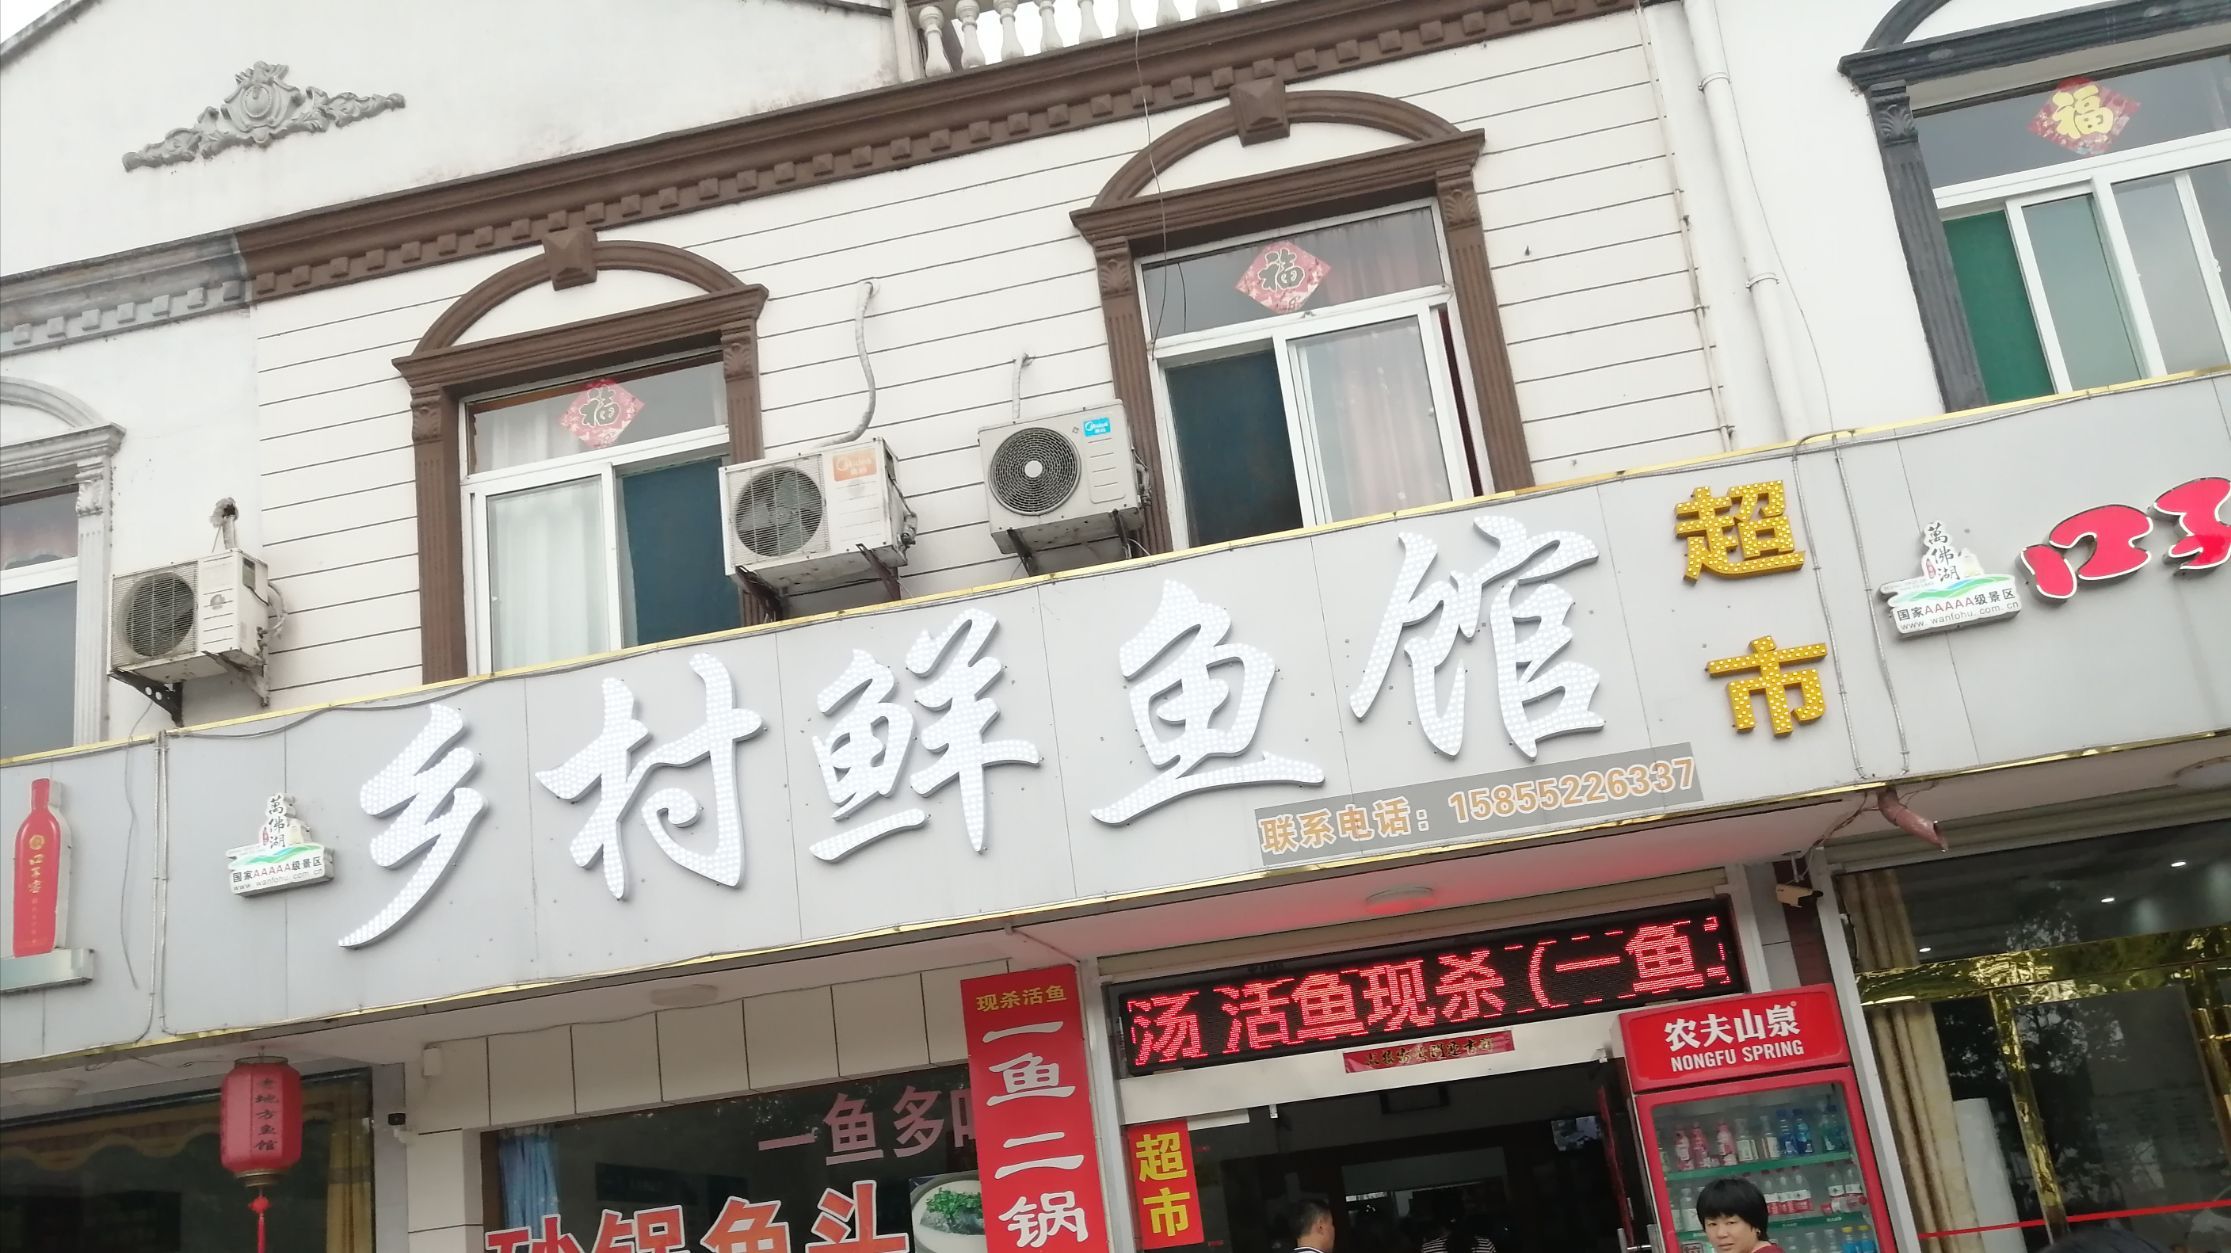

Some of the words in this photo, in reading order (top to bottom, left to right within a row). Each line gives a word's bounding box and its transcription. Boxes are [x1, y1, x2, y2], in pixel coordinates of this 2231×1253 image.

[2052, 84, 2114, 139] 福
[1257, 247, 1305, 291] 福
[579, 385, 621, 427] 福
[1675, 479, 1828, 738] 超市
[1896, 588, 2016, 621] 国家AAAAA级景区
[338, 514, 1606, 950] 乡村鲜鱼馆
[1448, 757, 1697, 824] 15855226337
[976, 985, 1067, 1012] 现杀活鱼
[1664, 1004, 1801, 1052] 农夫山泉
[1671, 1048, 1737, 1072] NONGFU
[1742, 1039, 1804, 1062] SPRING
[982, 1020, 1089, 1248] 一鱼二锅
[1135, 1131, 1191, 1237] 超市
